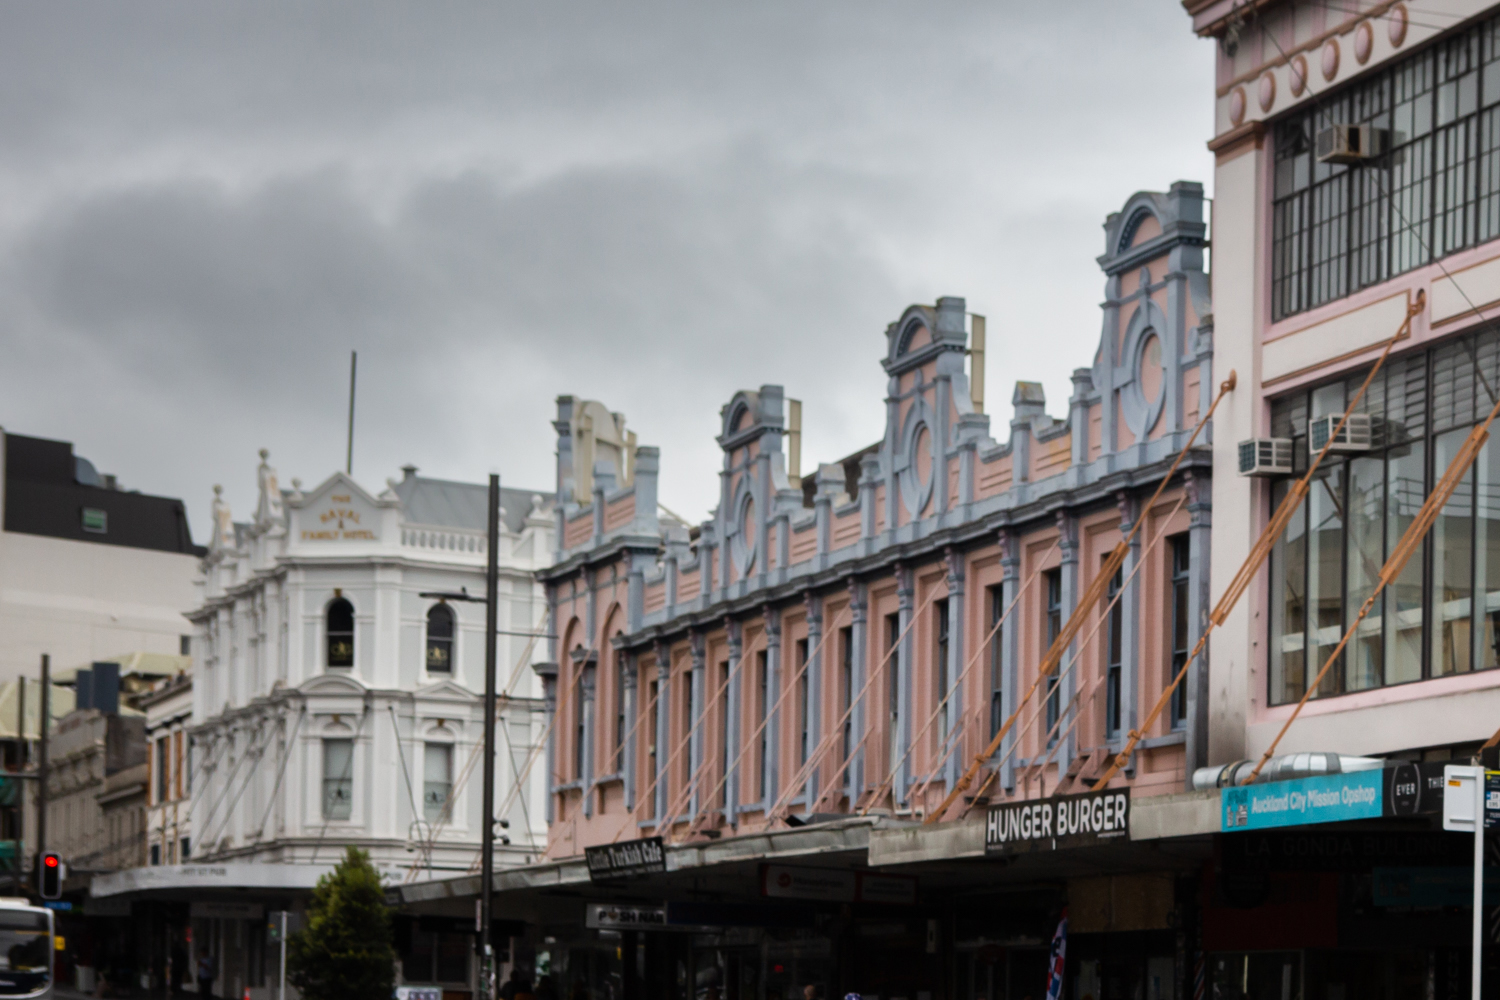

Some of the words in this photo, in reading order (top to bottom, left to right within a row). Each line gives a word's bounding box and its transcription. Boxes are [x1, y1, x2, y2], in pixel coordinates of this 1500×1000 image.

[1252, 793, 1289, 814] Auckland
[1290, 790, 1307, 812] City
[1307, 786, 1340, 808] Mission
[1341, 784, 1376, 807] Opshop
[1396, 783, 1415, 796] EVER
[987, 803, 1053, 843] HUNGER
[1056, 793, 1126, 837] BURGER
[608, 843, 642, 868] Turkish
